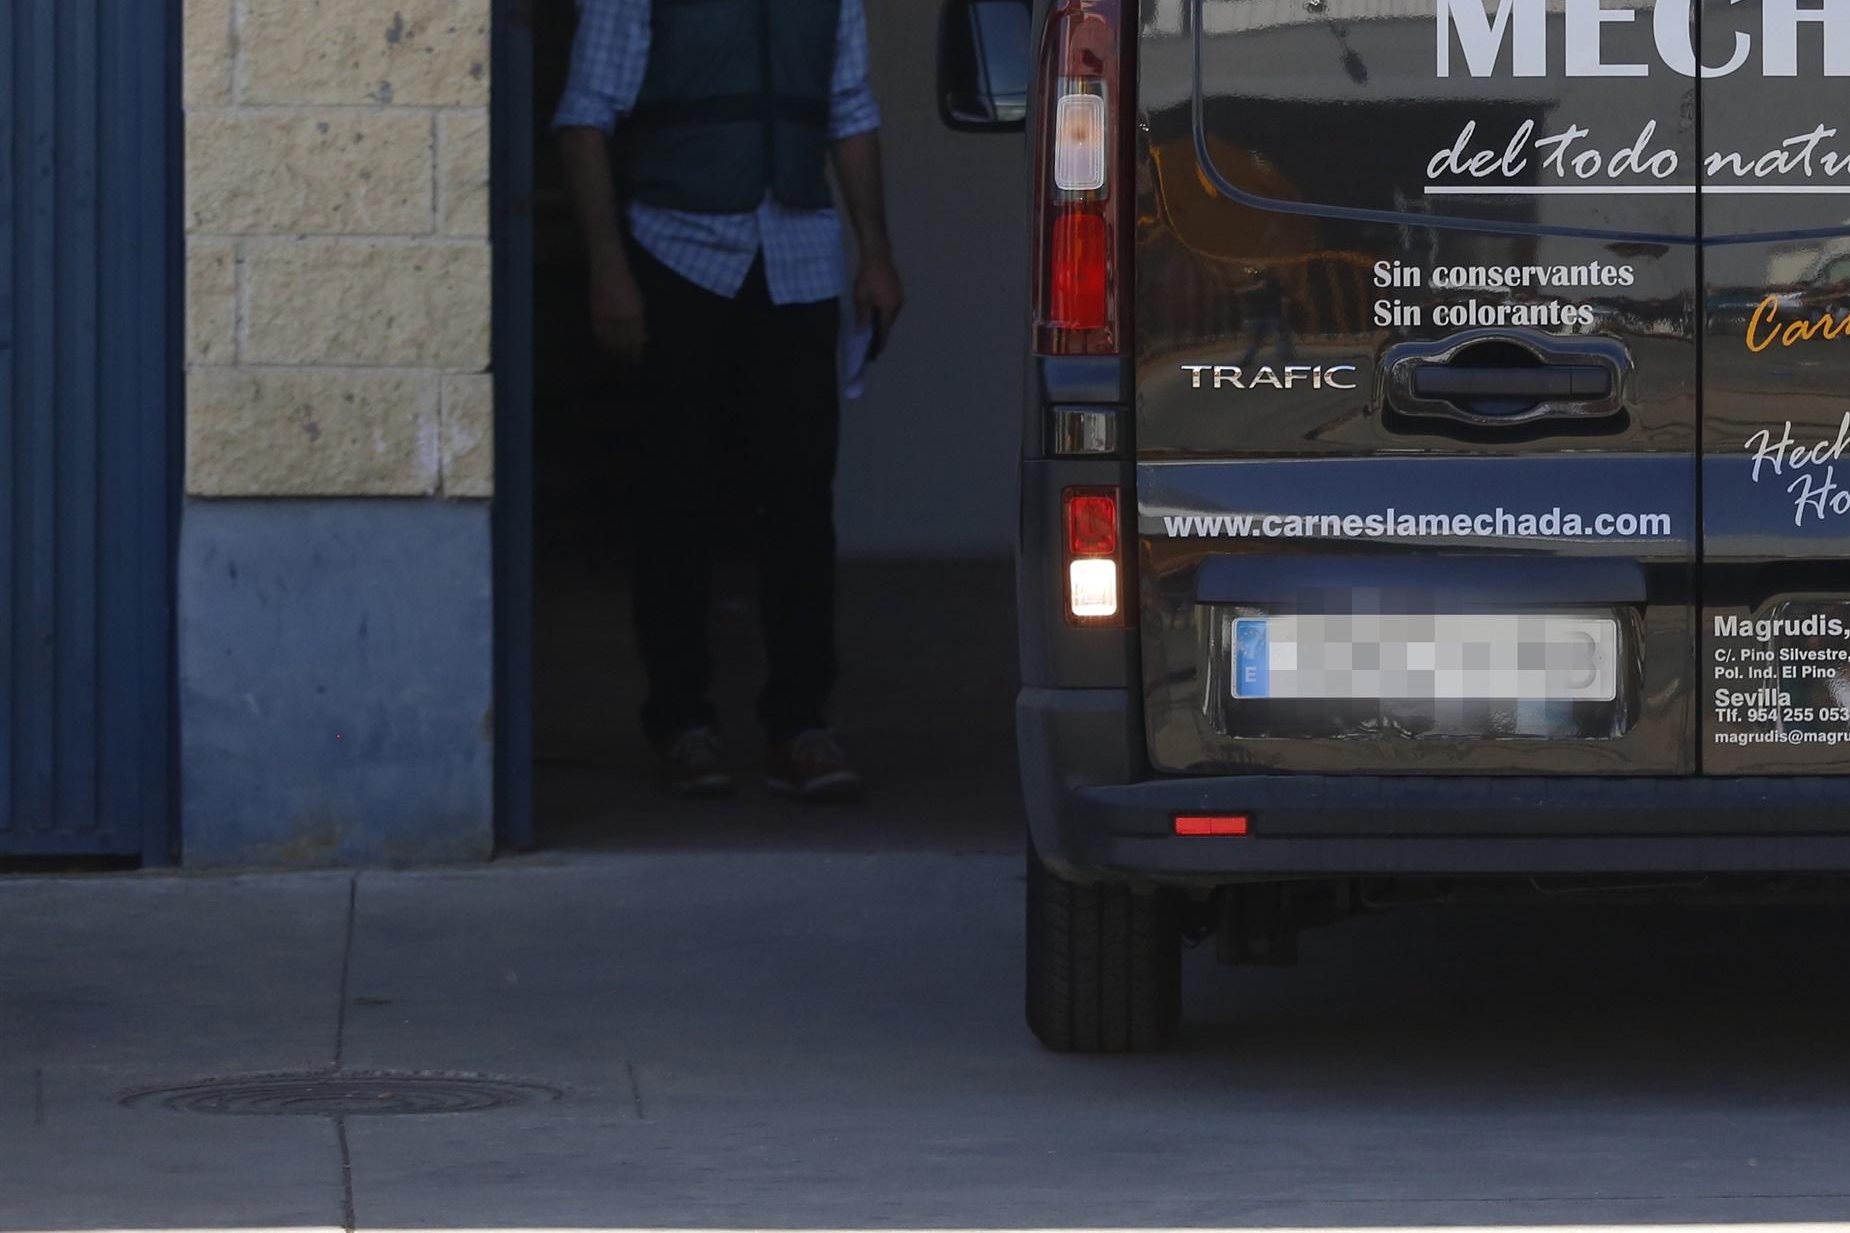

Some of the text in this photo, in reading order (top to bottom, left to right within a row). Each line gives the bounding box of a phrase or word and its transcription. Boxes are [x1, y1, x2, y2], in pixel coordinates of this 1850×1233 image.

[1426, 118, 1534, 179] del
[1534, 118, 1680, 179] todo
[1373, 260, 1635, 288] Sin conservantes
[1373, 299, 1595, 327] Sin colorantes
[1180, 364, 1359, 391] TRAFIC
[1163, 507, 1672, 539] www.carneslamechada.com
[1713, 614, 1850, 642] Magrudis,
[1713, 648, 1736, 663] C/.
[1740, 647, 1775, 662] Pino
[1244, 666, 1257, 684] E
[1713, 665, 1837, 680] Pol. Ind. El Pino
[1714, 687, 1792, 709] Sevilla
[1714, 706, 1850, 723] Tlf. 954 255 053
